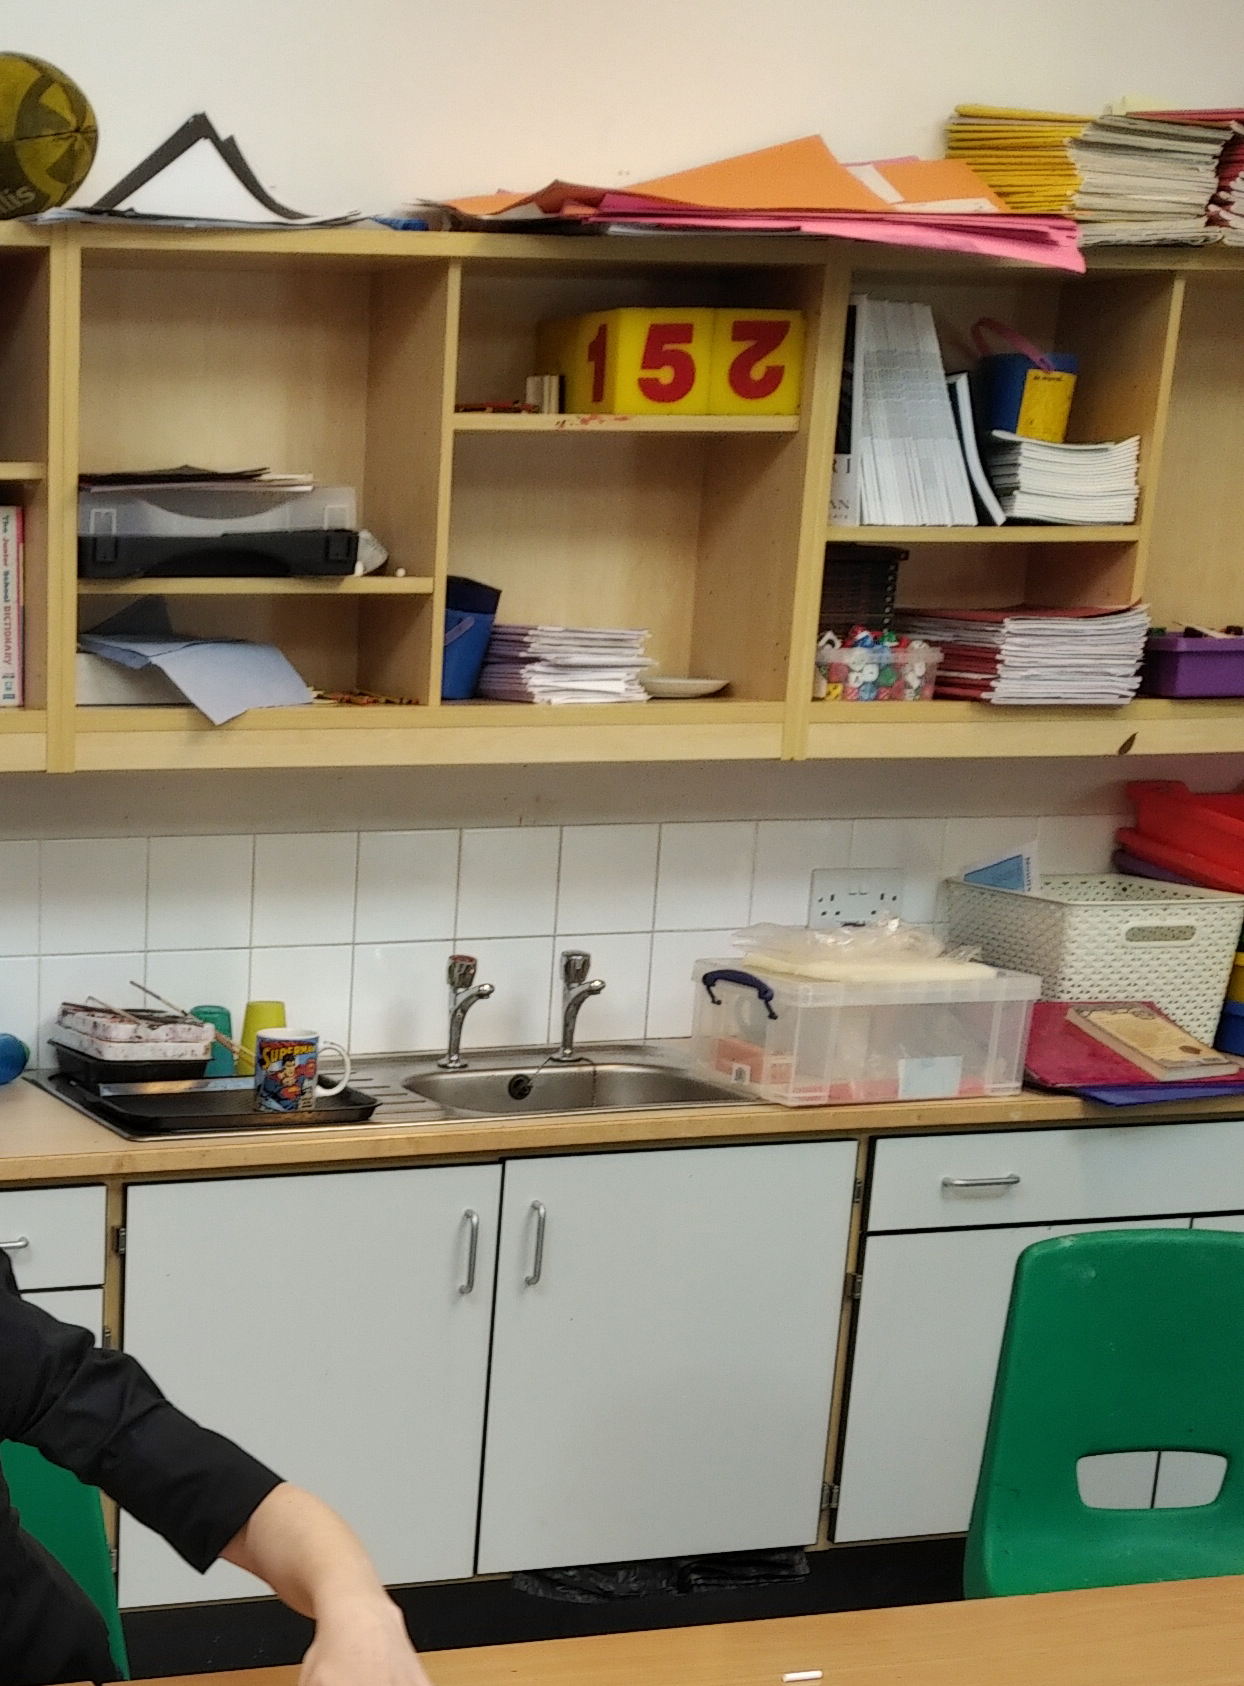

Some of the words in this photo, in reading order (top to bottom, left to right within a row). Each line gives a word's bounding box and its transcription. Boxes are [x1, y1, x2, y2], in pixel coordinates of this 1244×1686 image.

[587, 324, 608, 404] 1
[638, 323, 696, 403] 5
[2, 606, 12, 664] DICTIONARY
